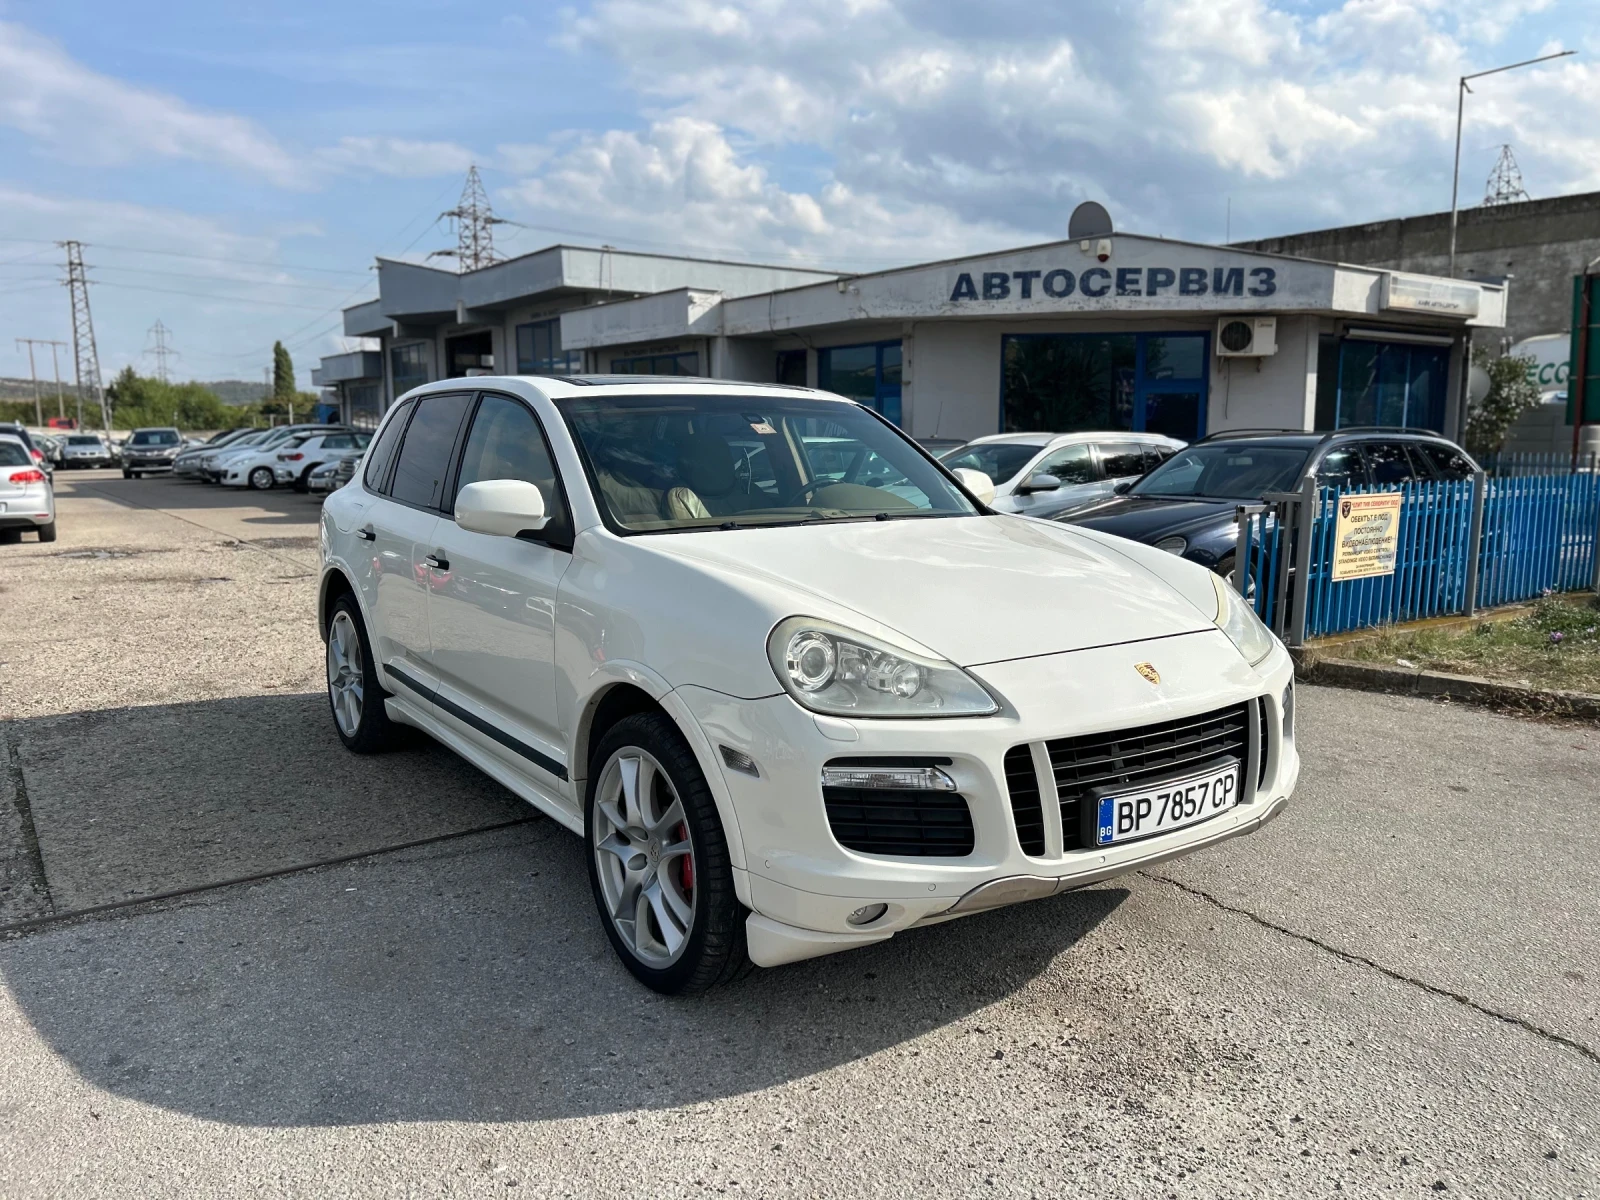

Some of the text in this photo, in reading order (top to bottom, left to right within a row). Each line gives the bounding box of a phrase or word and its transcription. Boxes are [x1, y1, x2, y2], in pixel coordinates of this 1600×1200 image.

[950, 267, 1277, 300] АВТОСЕРВИЗ
[1351, 514, 1373, 523] ОБЕКТЪТ
[1354, 525, 1383, 535] ПОСТОЯННО
[1117, 773, 1234, 834] BP 7857 CP
[1100, 826, 1112, 837] BG
